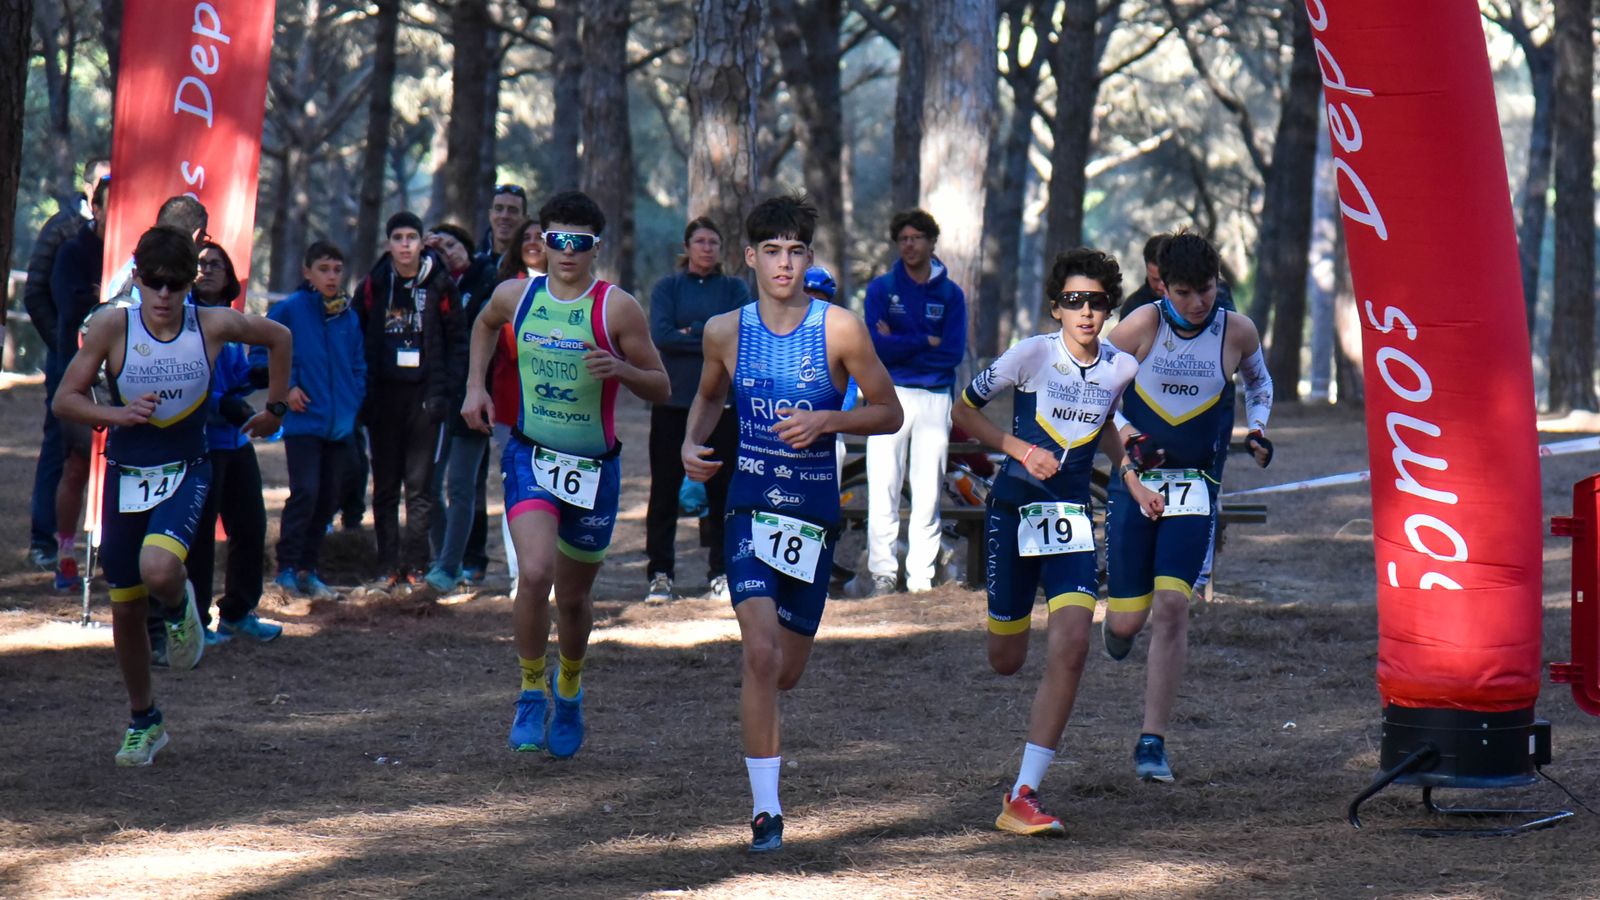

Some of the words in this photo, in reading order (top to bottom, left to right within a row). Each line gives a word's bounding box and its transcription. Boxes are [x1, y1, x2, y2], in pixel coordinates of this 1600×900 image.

[555, 340, 584, 350] VERDE
[139, 359, 205, 375] MONTEROS
[154, 357, 176, 365] HOTEL
[531, 357, 578, 381] CASTRO
[1163, 359, 1216, 370] MONTEROS
[1161, 383, 1199, 396] TORO
[532, 403, 591, 423] bike&you
[751, 397, 813, 421] RICO
[754, 423, 778, 434] MAR
[139, 477, 169, 502] 14
[548, 466, 582, 495] 16
[1158, 482, 1192, 506] 17
[1037, 517, 1073, 545] 19
[769, 530, 803, 565] 18
[744, 579, 766, 590] EDM
